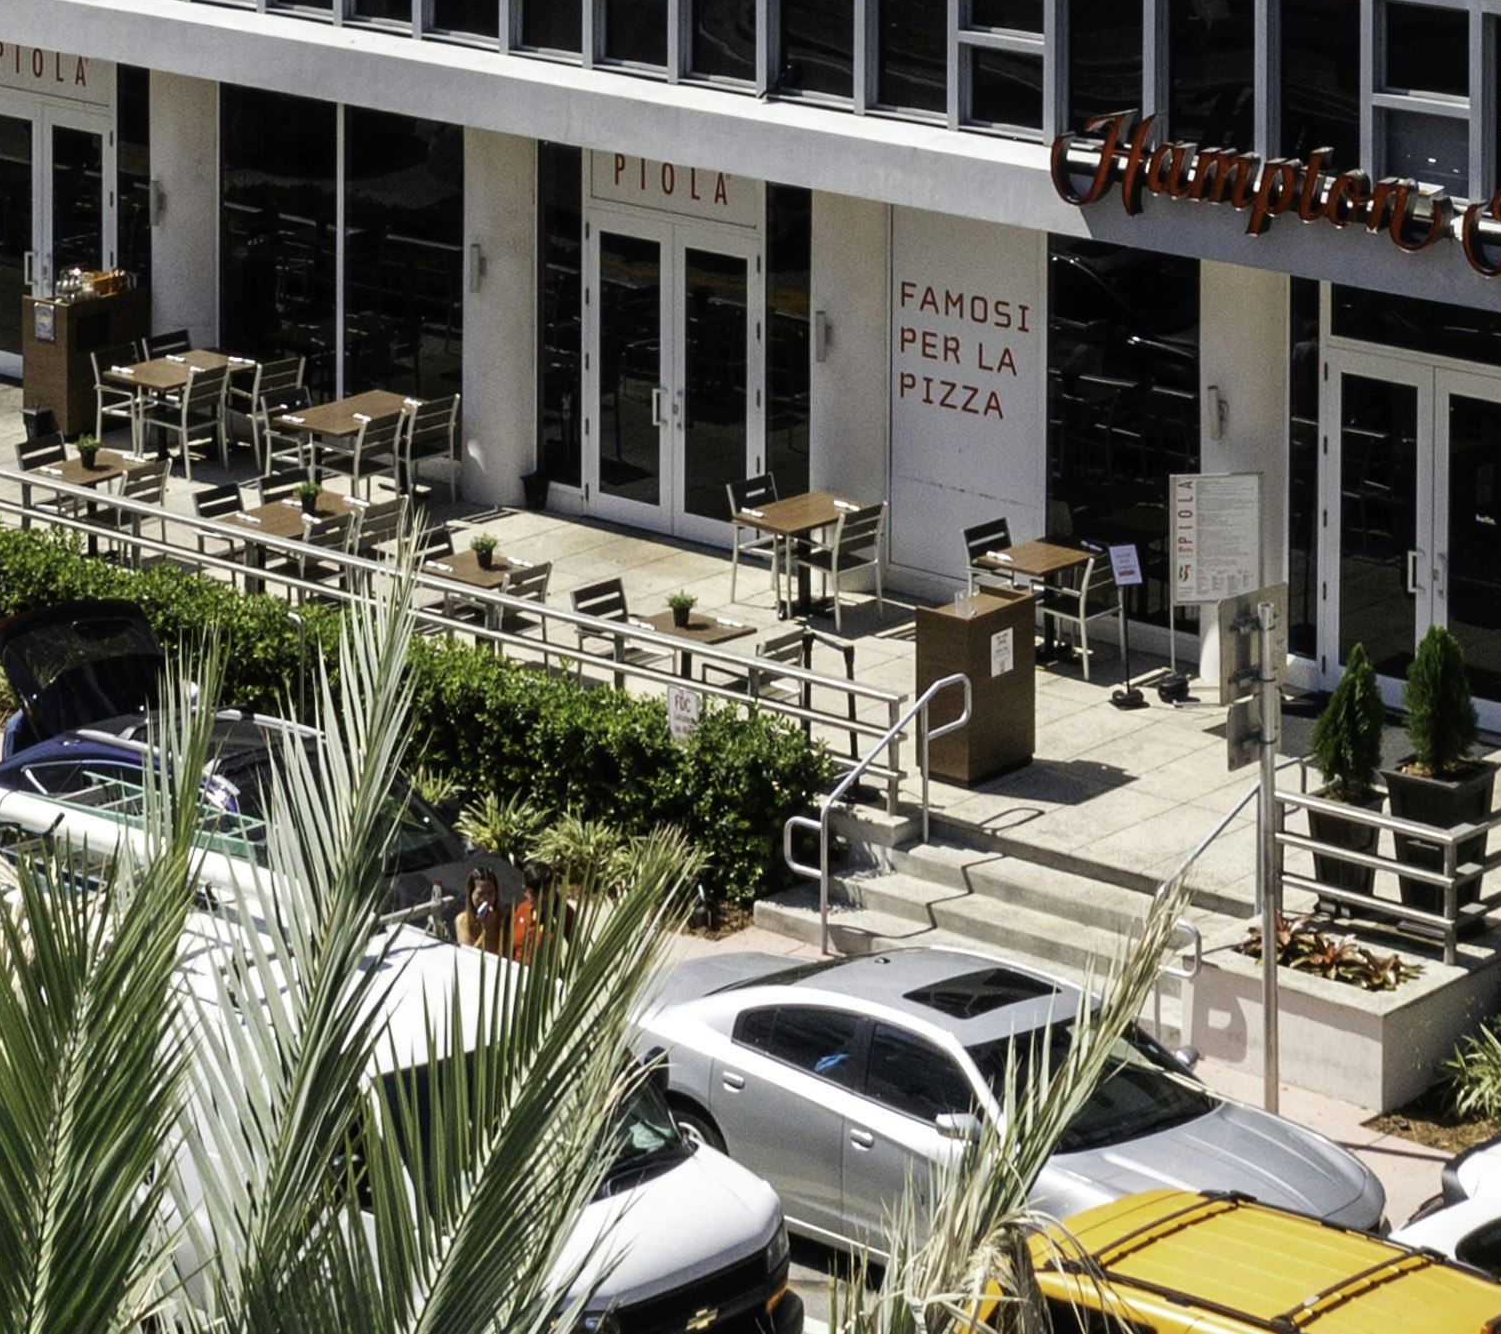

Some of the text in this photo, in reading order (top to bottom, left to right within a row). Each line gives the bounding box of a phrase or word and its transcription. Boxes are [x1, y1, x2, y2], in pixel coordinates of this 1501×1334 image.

[614, 153, 728, 205] PIOLA
[1049, 109, 1450, 252] Hampton
[901, 281, 1029, 332] FAMOSI
[901, 326, 1017, 376] PER LA
[900, 372, 1003, 419] PIZZA
[1178, 481, 1194, 544] PIOLA
